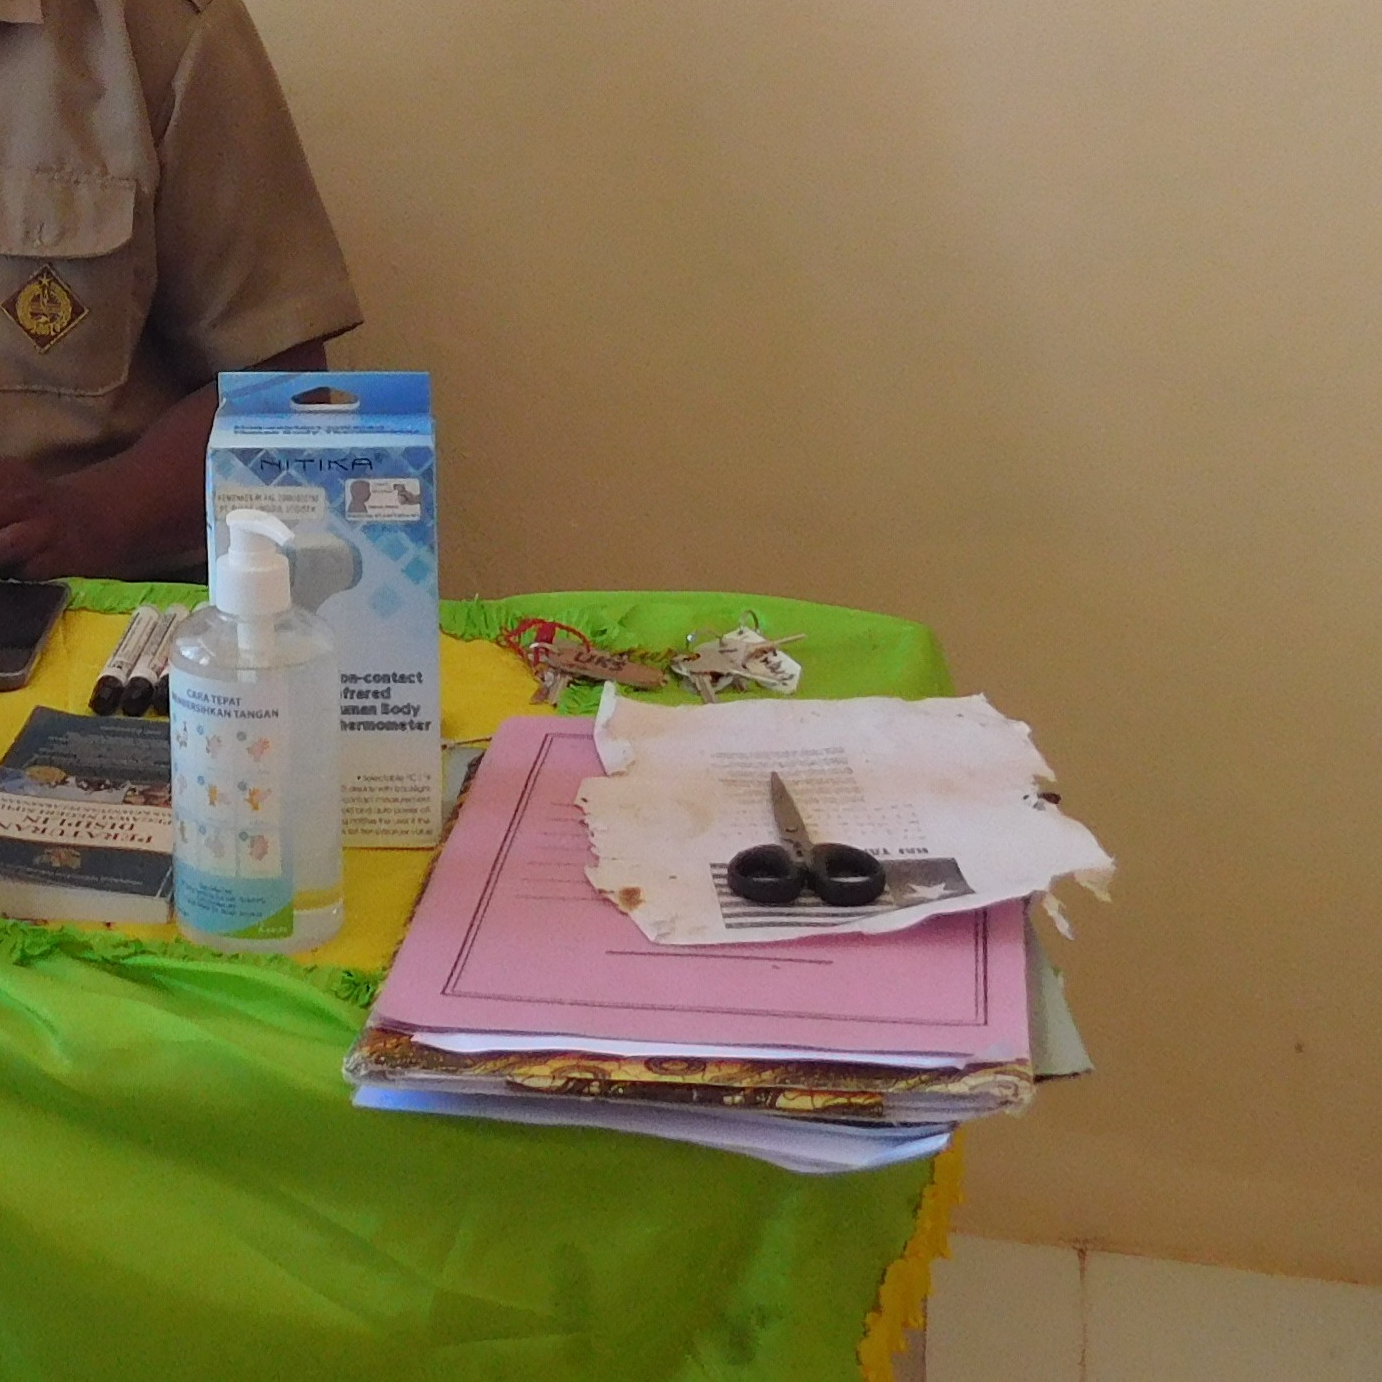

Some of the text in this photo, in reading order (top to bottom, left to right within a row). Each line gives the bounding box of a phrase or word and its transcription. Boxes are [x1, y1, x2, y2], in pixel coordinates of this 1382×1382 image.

[260, 458, 374, 471] NITIKA
[340, 671, 424, 684] on-contact
[186, 688, 242, 707] CARA TEPAT
[340, 686, 392, 700] frared
[233, 708, 280, 719] TANGAN
[340, 702, 421, 717] uman Body
[340, 719, 433, 732] hermometer
[22, 816, 135, 832] DISIPLIN
